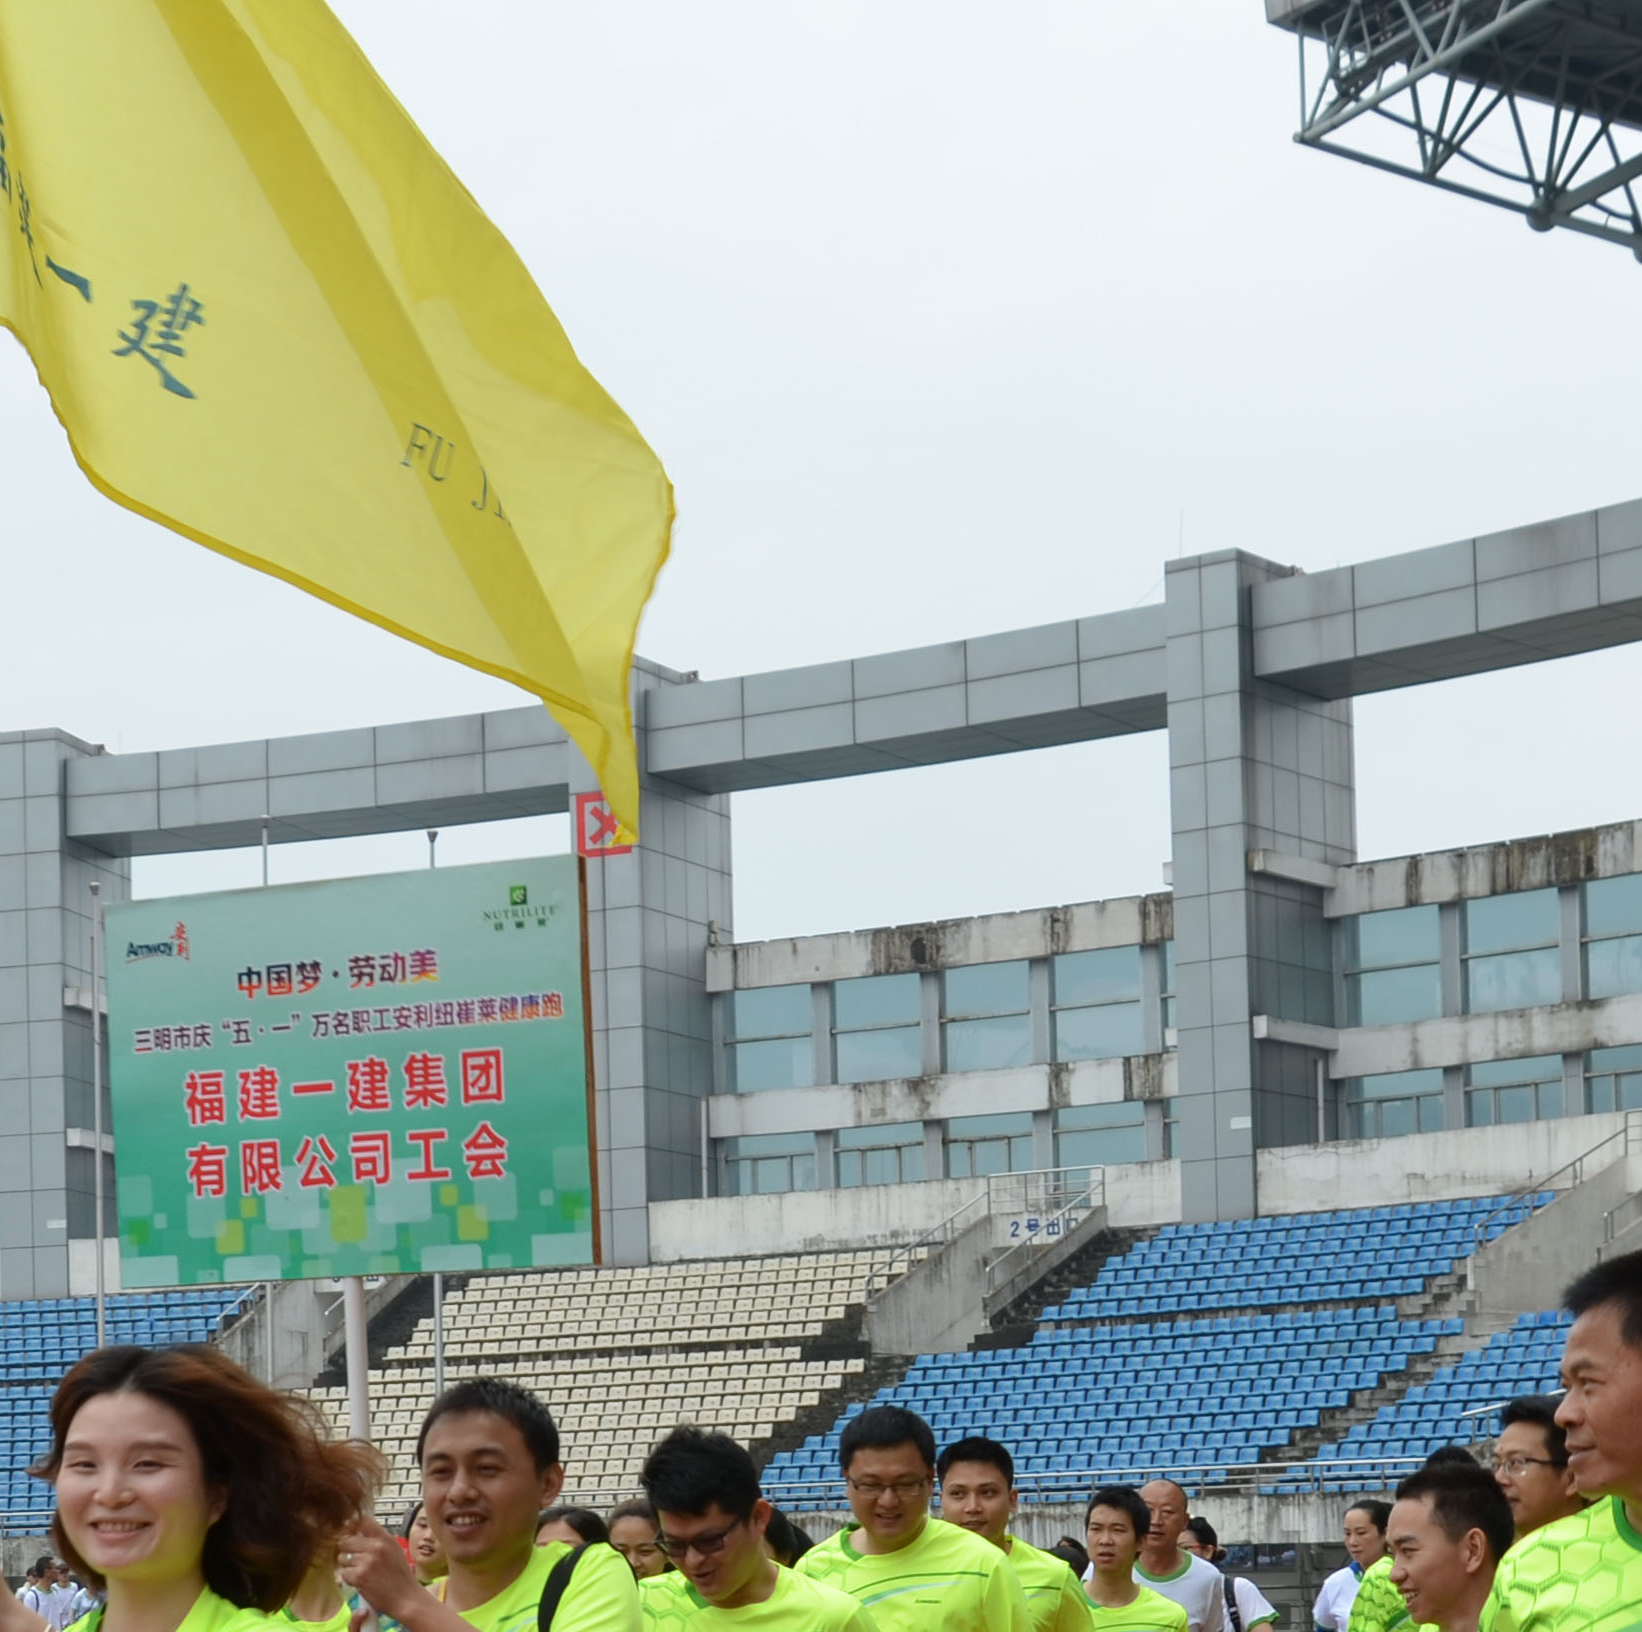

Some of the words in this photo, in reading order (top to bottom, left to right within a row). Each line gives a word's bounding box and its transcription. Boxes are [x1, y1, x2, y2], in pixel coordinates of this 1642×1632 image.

[399, 421, 456, 483] FU
[184, 1048, 504, 1127] 福建一建集团
[186, 1122, 509, 1198] 有限公司工会
